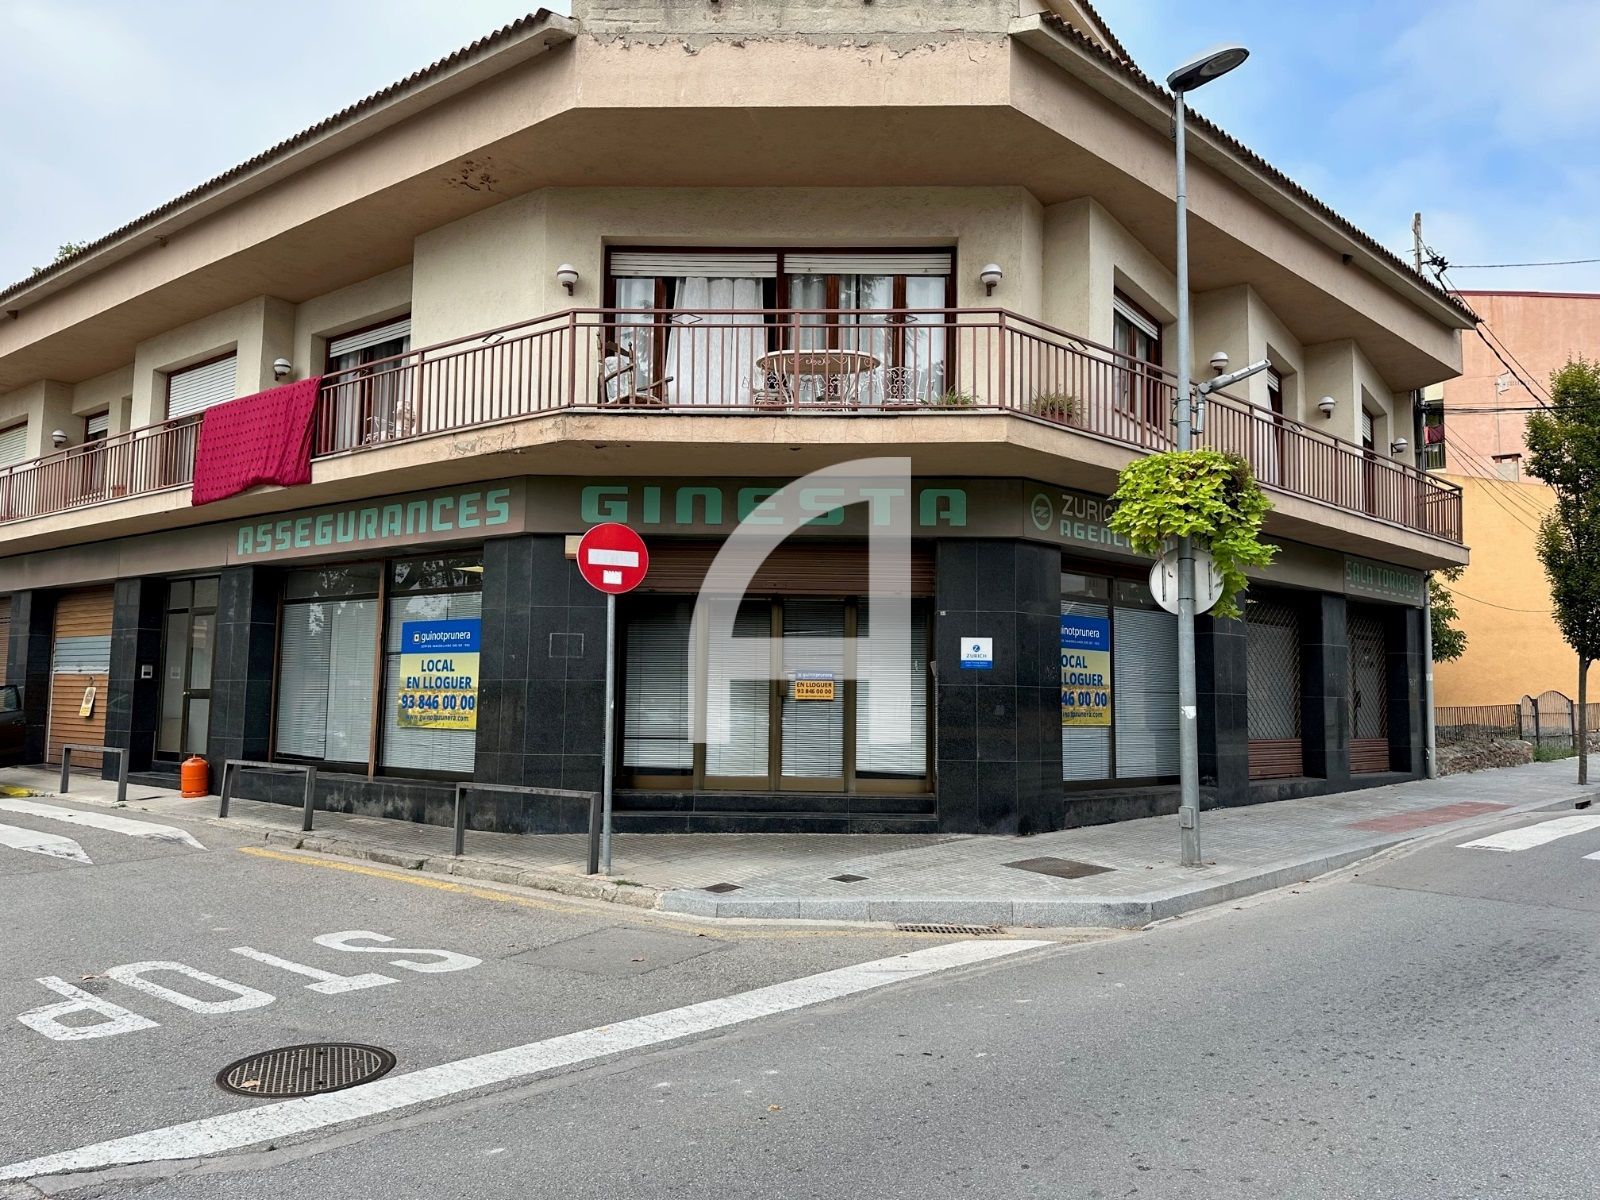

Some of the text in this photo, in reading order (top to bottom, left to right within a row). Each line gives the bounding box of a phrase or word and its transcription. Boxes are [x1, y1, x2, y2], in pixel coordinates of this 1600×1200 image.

[581, 486, 967, 526] GINESTA
[1061, 494, 1118, 523] ZURIC
[237, 488, 510, 556] ASSEGURANCES
[1345, 561, 1373, 585] SALA
[421, 631, 471, 643] guinotprunera
[1060, 625, 1100, 638] inotprunera
[421, 659, 455, 673] LOCAL
[1060, 654, 1088, 669] OCAL
[406, 676, 472, 690] EN LLOGUER
[1060, 672, 1104, 687] LOGUER
[401, 694, 475, 710] 93 846 00 00
[1061, 691, 1108, 707] 46 00 00
[1062, 710, 1103, 719] inotprunera.com
[16, 930, 483, 1041] STOP
